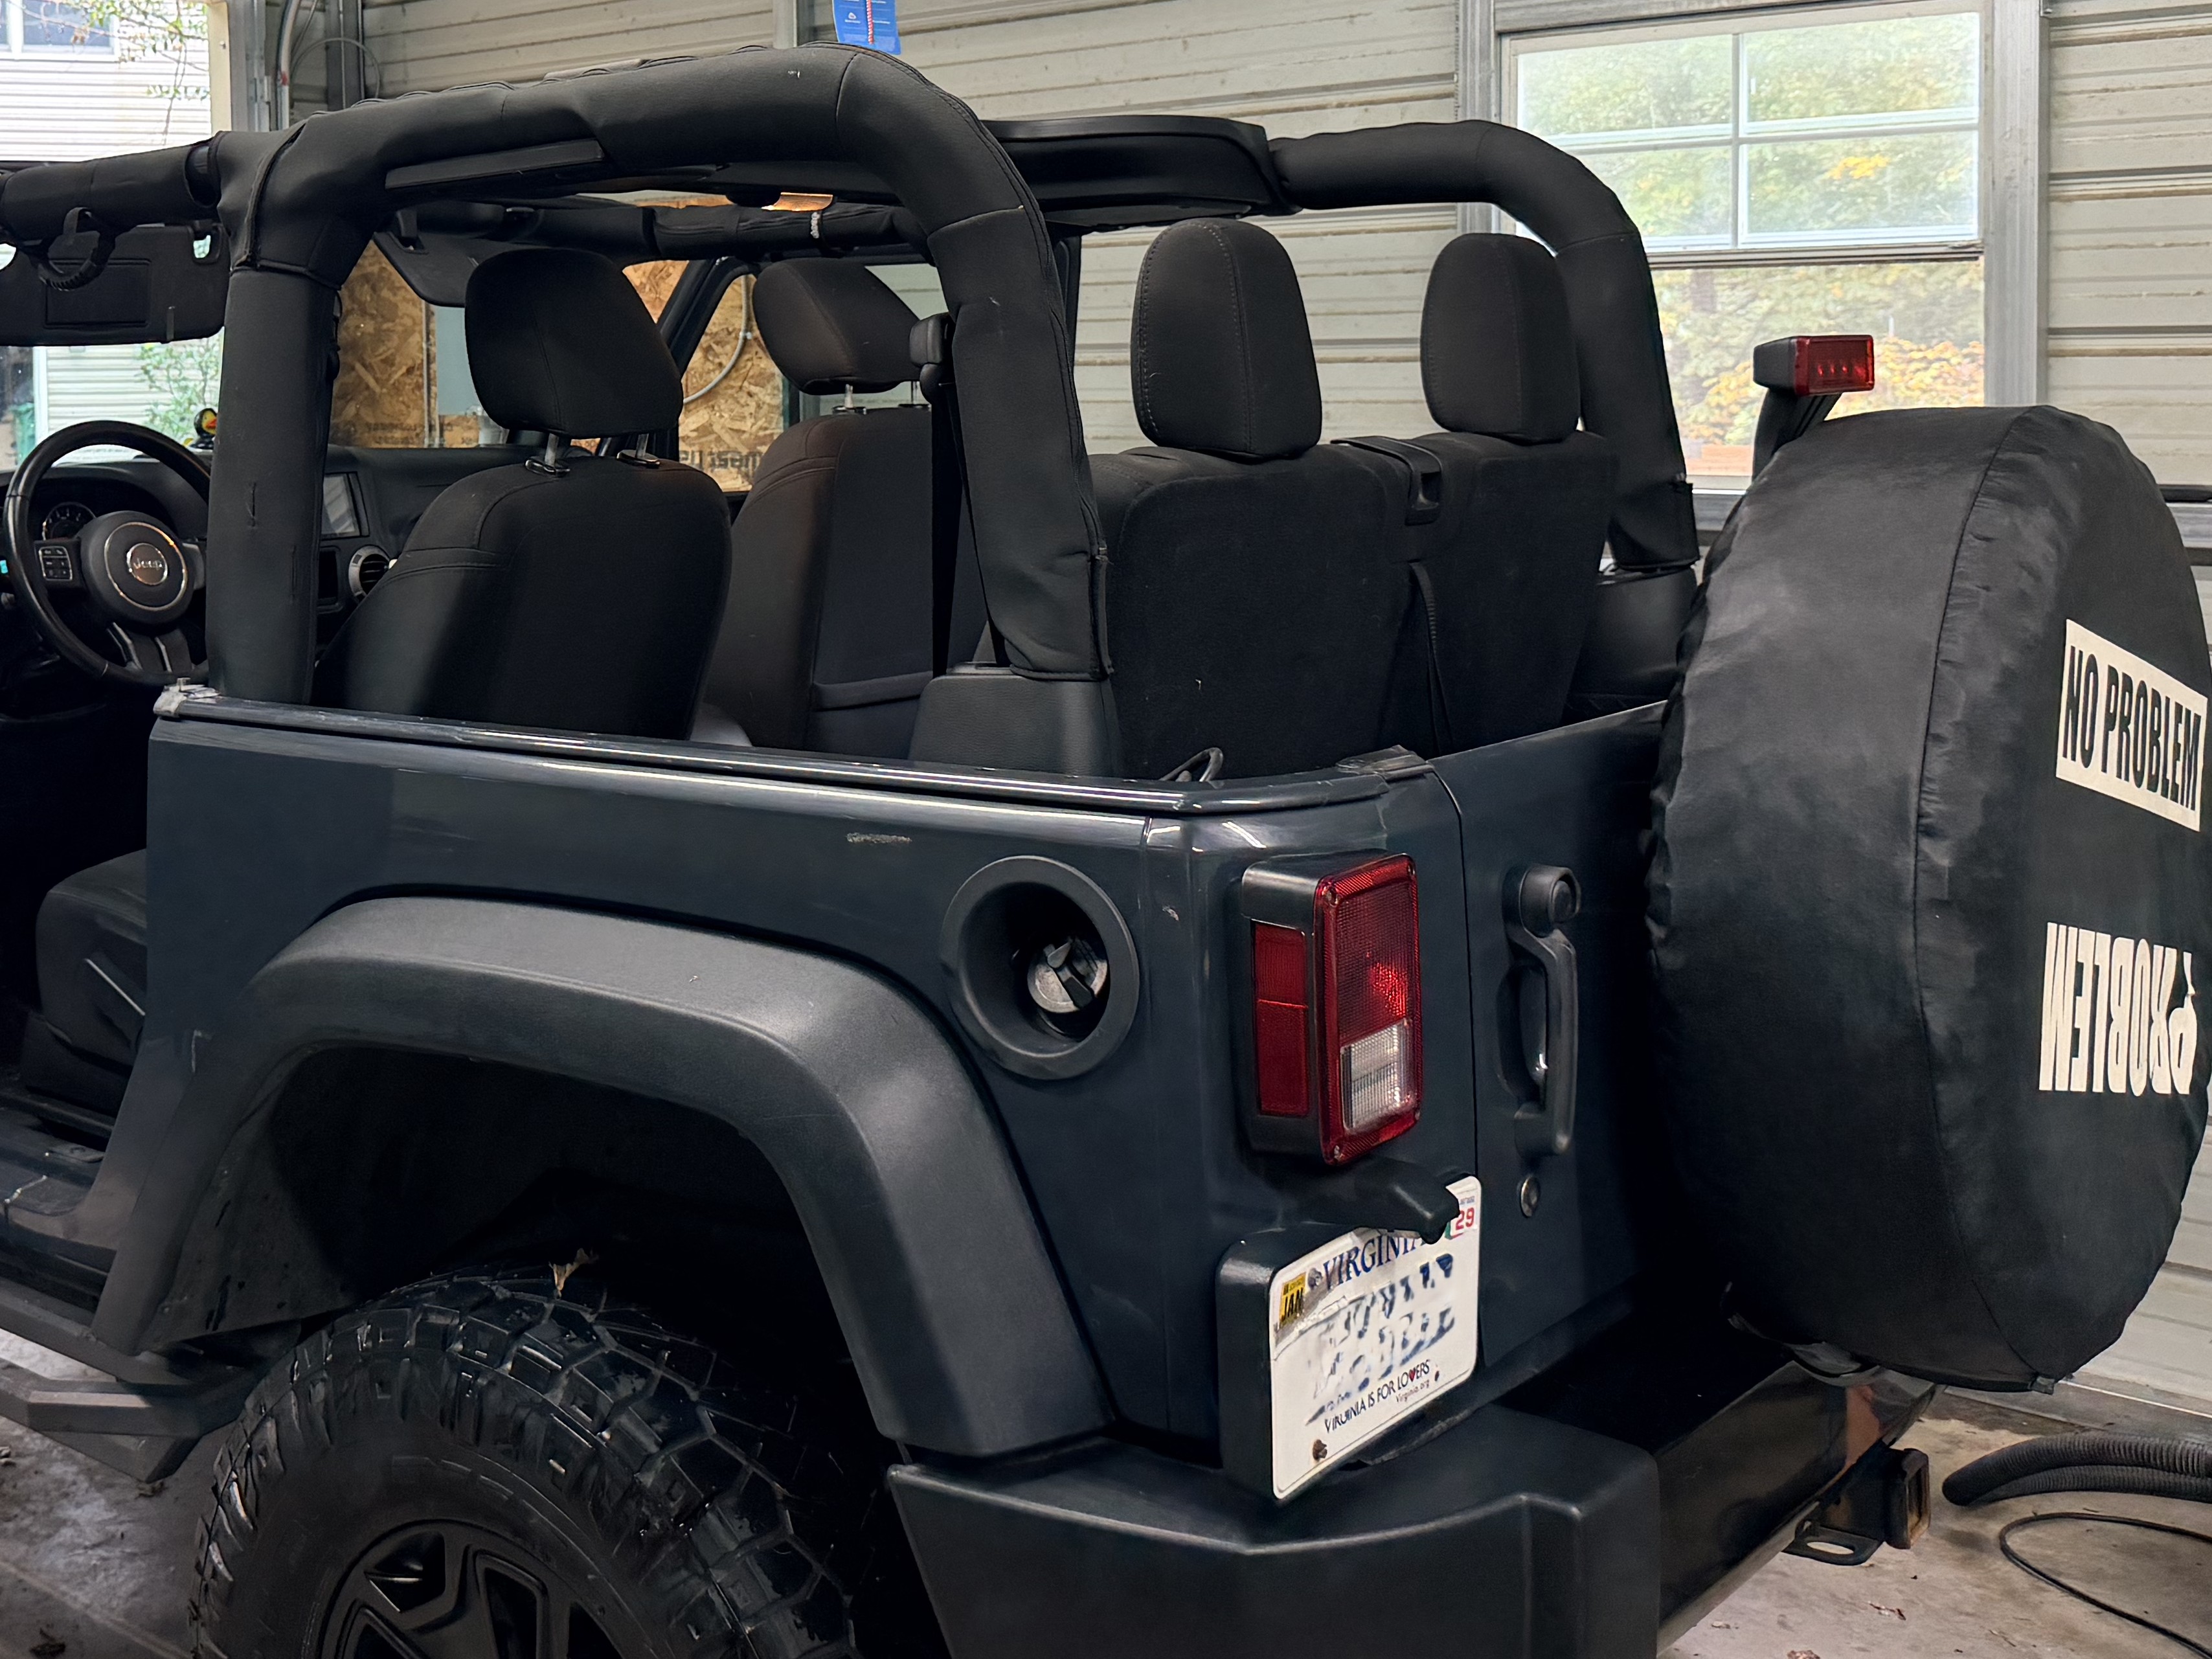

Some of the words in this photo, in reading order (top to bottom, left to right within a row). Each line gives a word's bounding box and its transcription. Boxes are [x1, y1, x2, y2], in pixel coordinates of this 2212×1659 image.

[133, 557, 163, 570] Jeep
[2062, 645, 2099, 769] NO
[2101, 664, 2202, 811] PROBLEM
[2039, 921, 2198, 1096] PROBLEM
[1455, 1207, 1474, 1230] 29
[1281, 1287, 1304, 1322] JAN
[1325, 1397, 1366, 1433] VIRGINIA
[1368, 1391, 1375, 1408] IS
[1377, 1380, 1396, 1403] FOR
